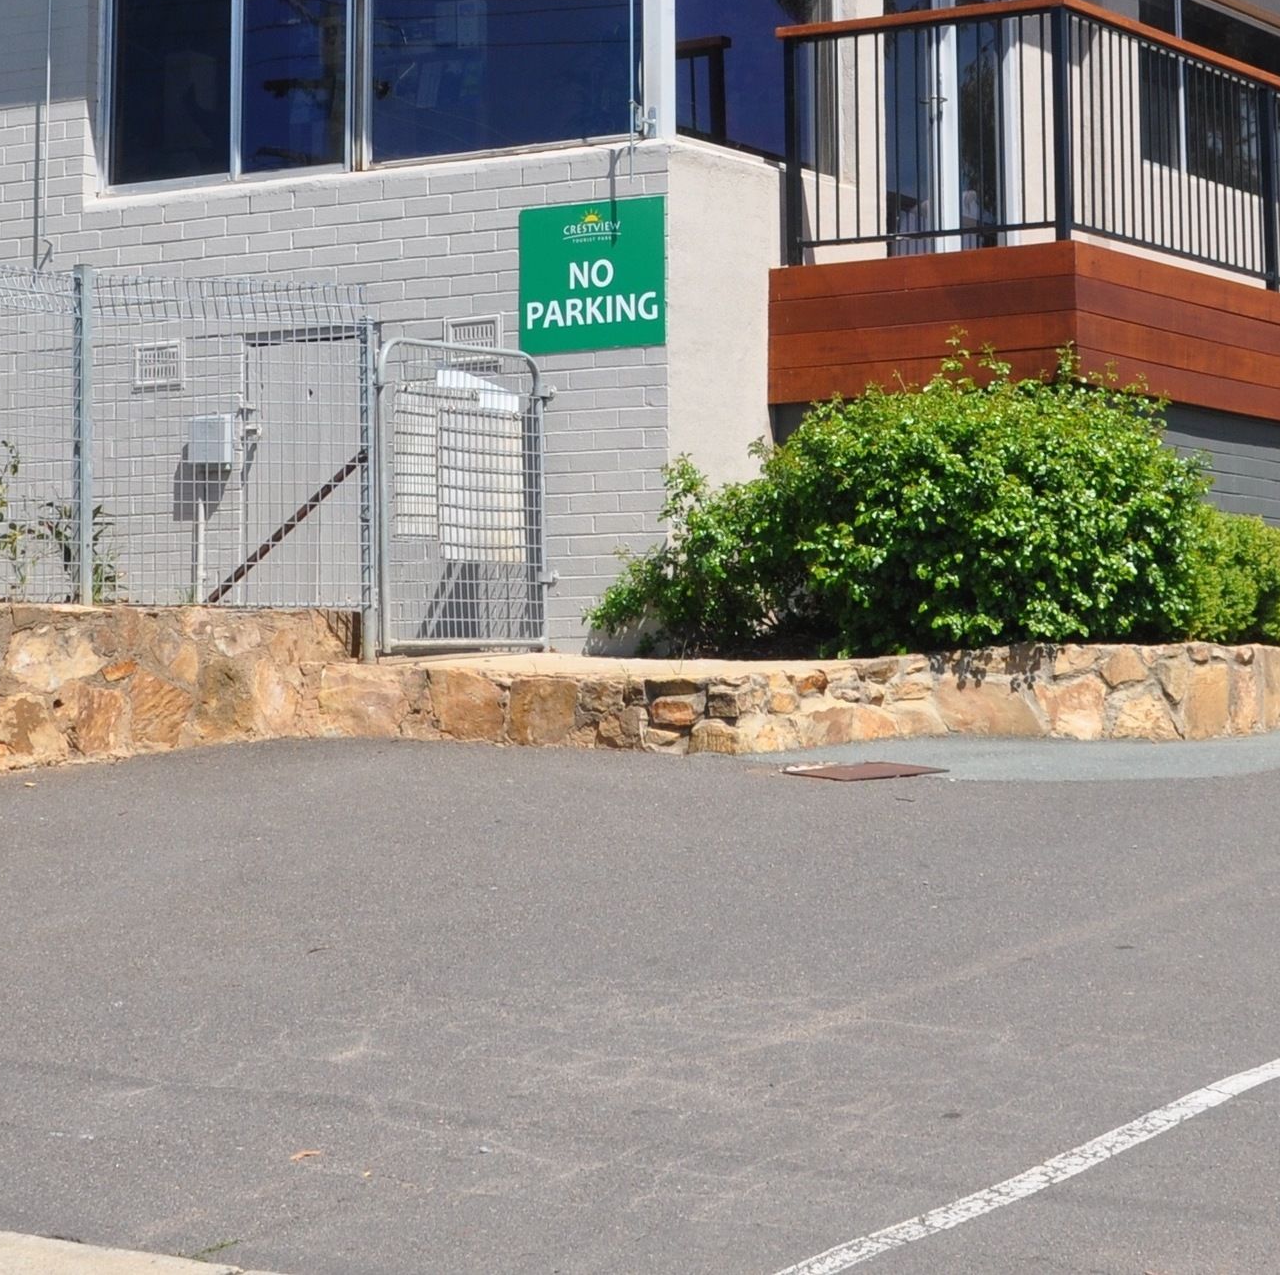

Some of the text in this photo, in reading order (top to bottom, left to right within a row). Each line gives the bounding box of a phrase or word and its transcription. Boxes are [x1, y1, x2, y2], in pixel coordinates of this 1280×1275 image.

[563, 220, 621, 235] CRESTVIEW
[569, 259, 614, 290] NO
[526, 291, 659, 330] PARKING
